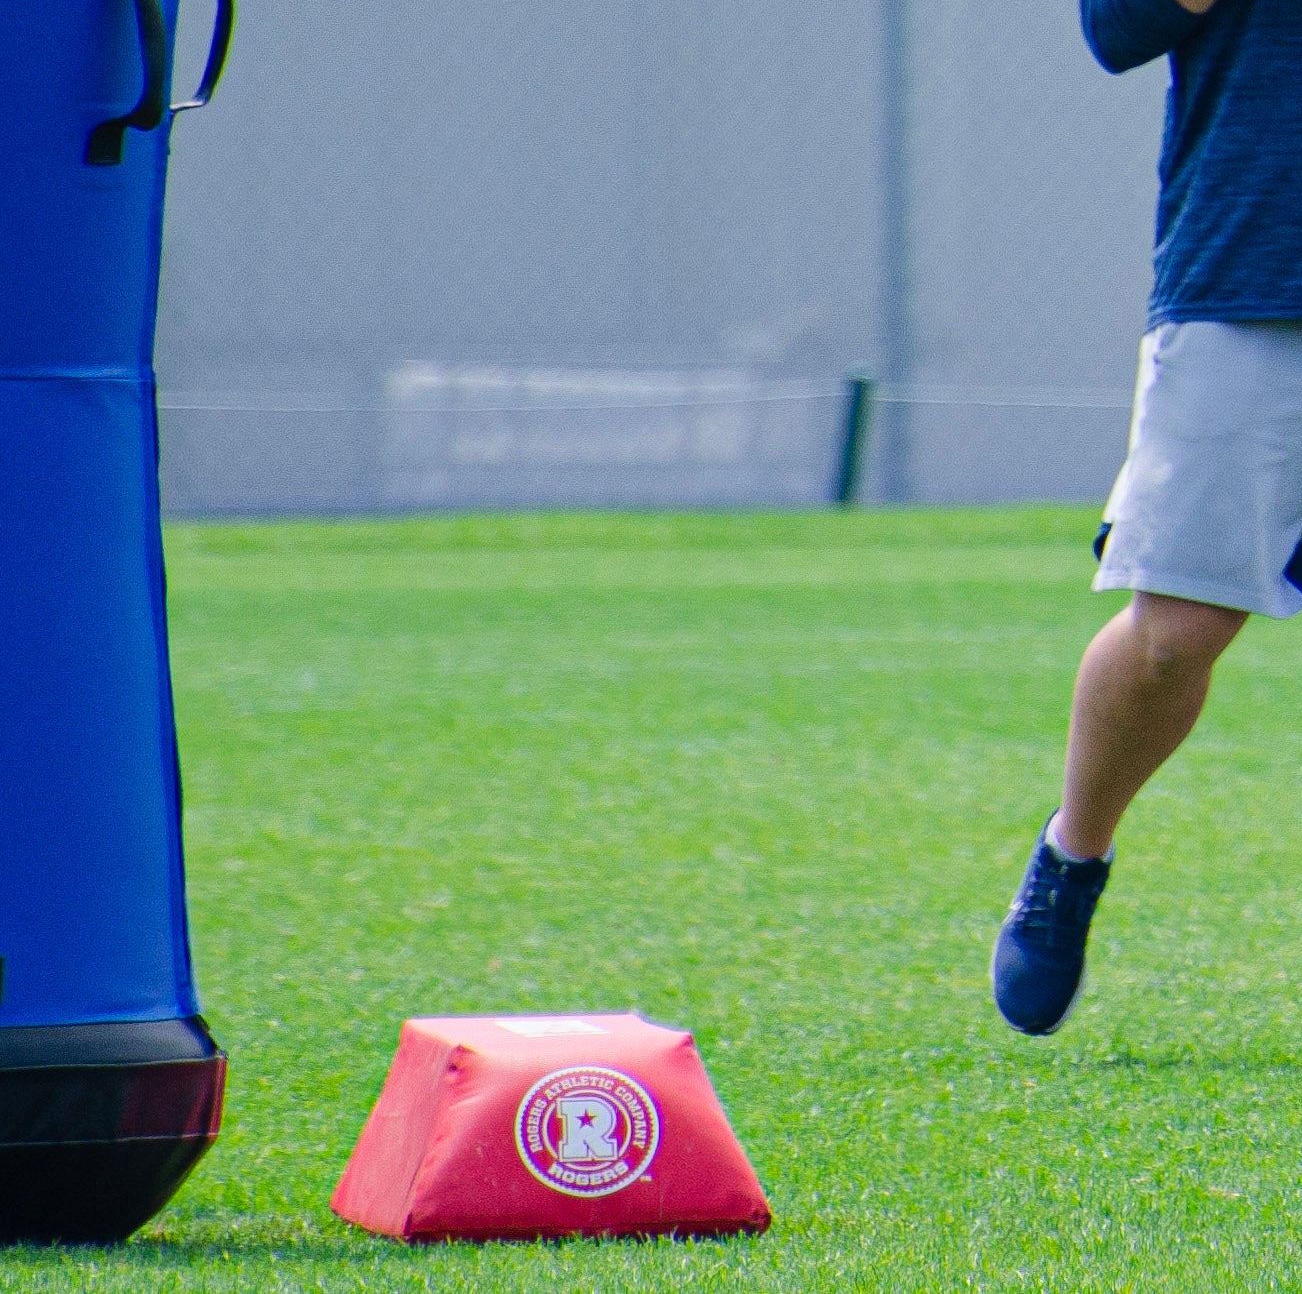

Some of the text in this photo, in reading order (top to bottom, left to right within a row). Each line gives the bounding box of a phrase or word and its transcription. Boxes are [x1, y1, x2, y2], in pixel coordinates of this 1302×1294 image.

[527, 1076, 647, 1153] ROGERS ATHLETIC COMPANY
[556, 1096, 618, 1162] R
[548, 1161, 629, 1186] ROGERS
